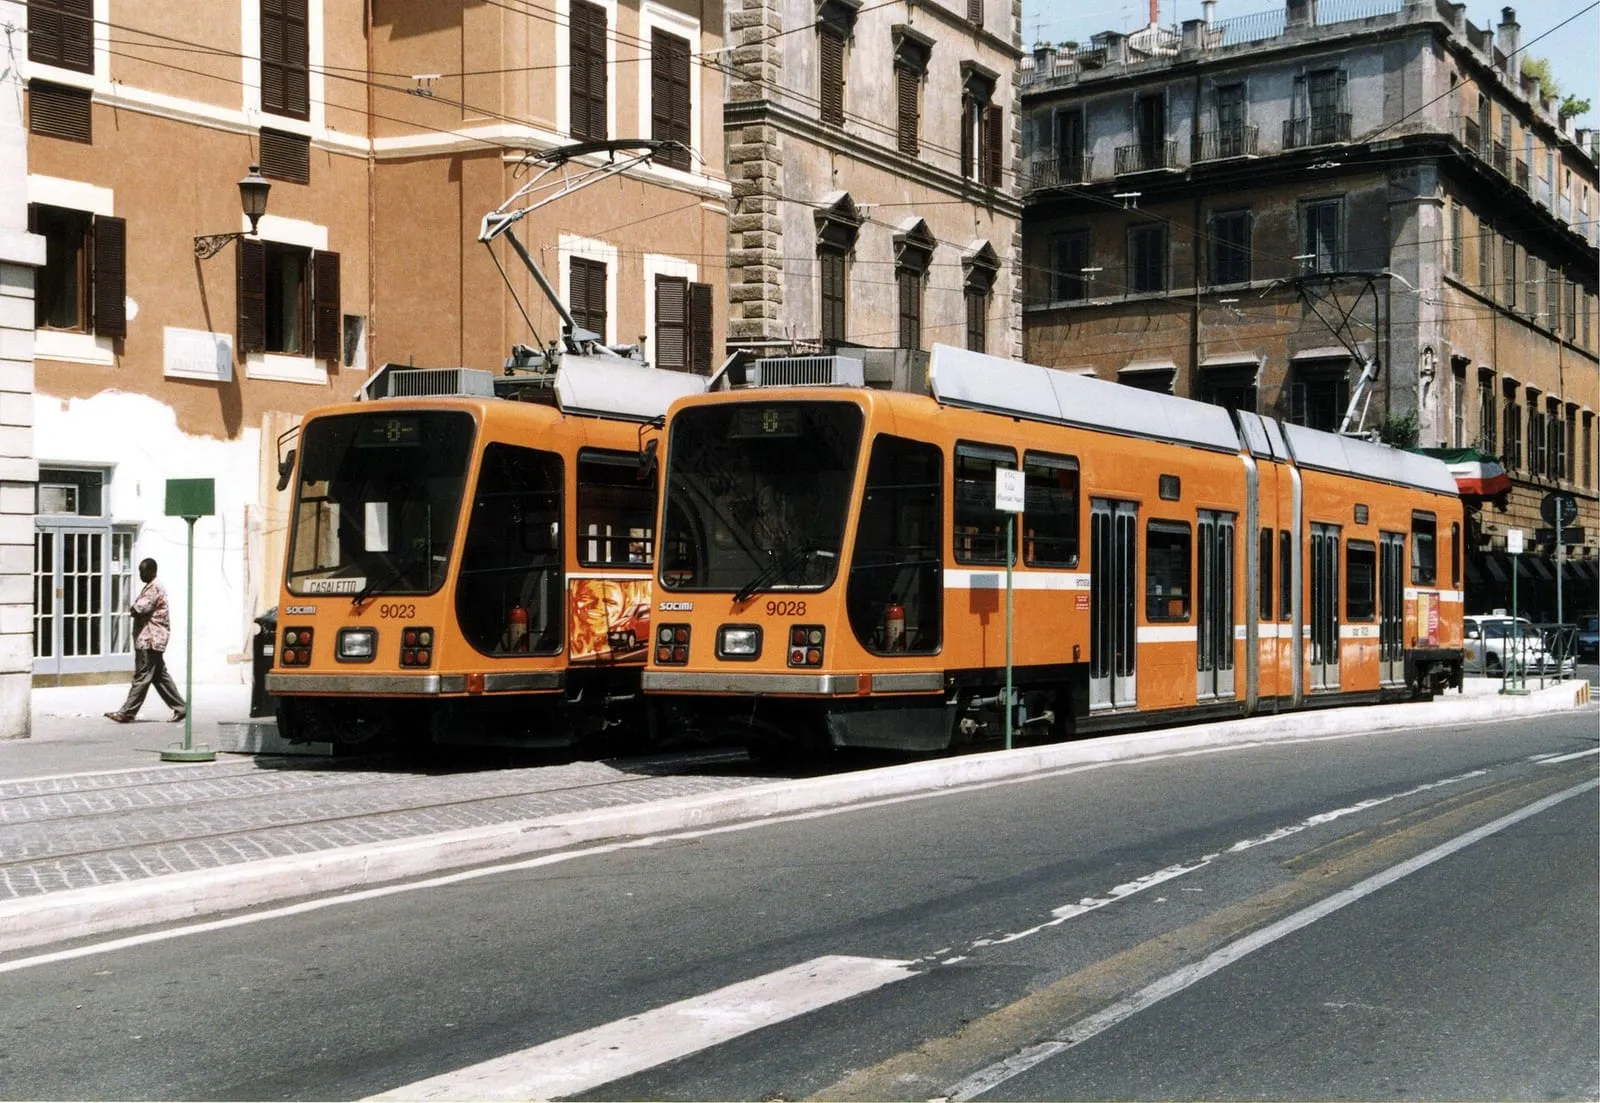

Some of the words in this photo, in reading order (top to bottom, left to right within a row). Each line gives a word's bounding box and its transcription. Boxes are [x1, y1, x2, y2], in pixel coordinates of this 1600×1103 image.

[310, 580, 357, 593] CASALETTO
[380, 604, 416, 618] 9023
[766, 601, 806, 616] 9028
